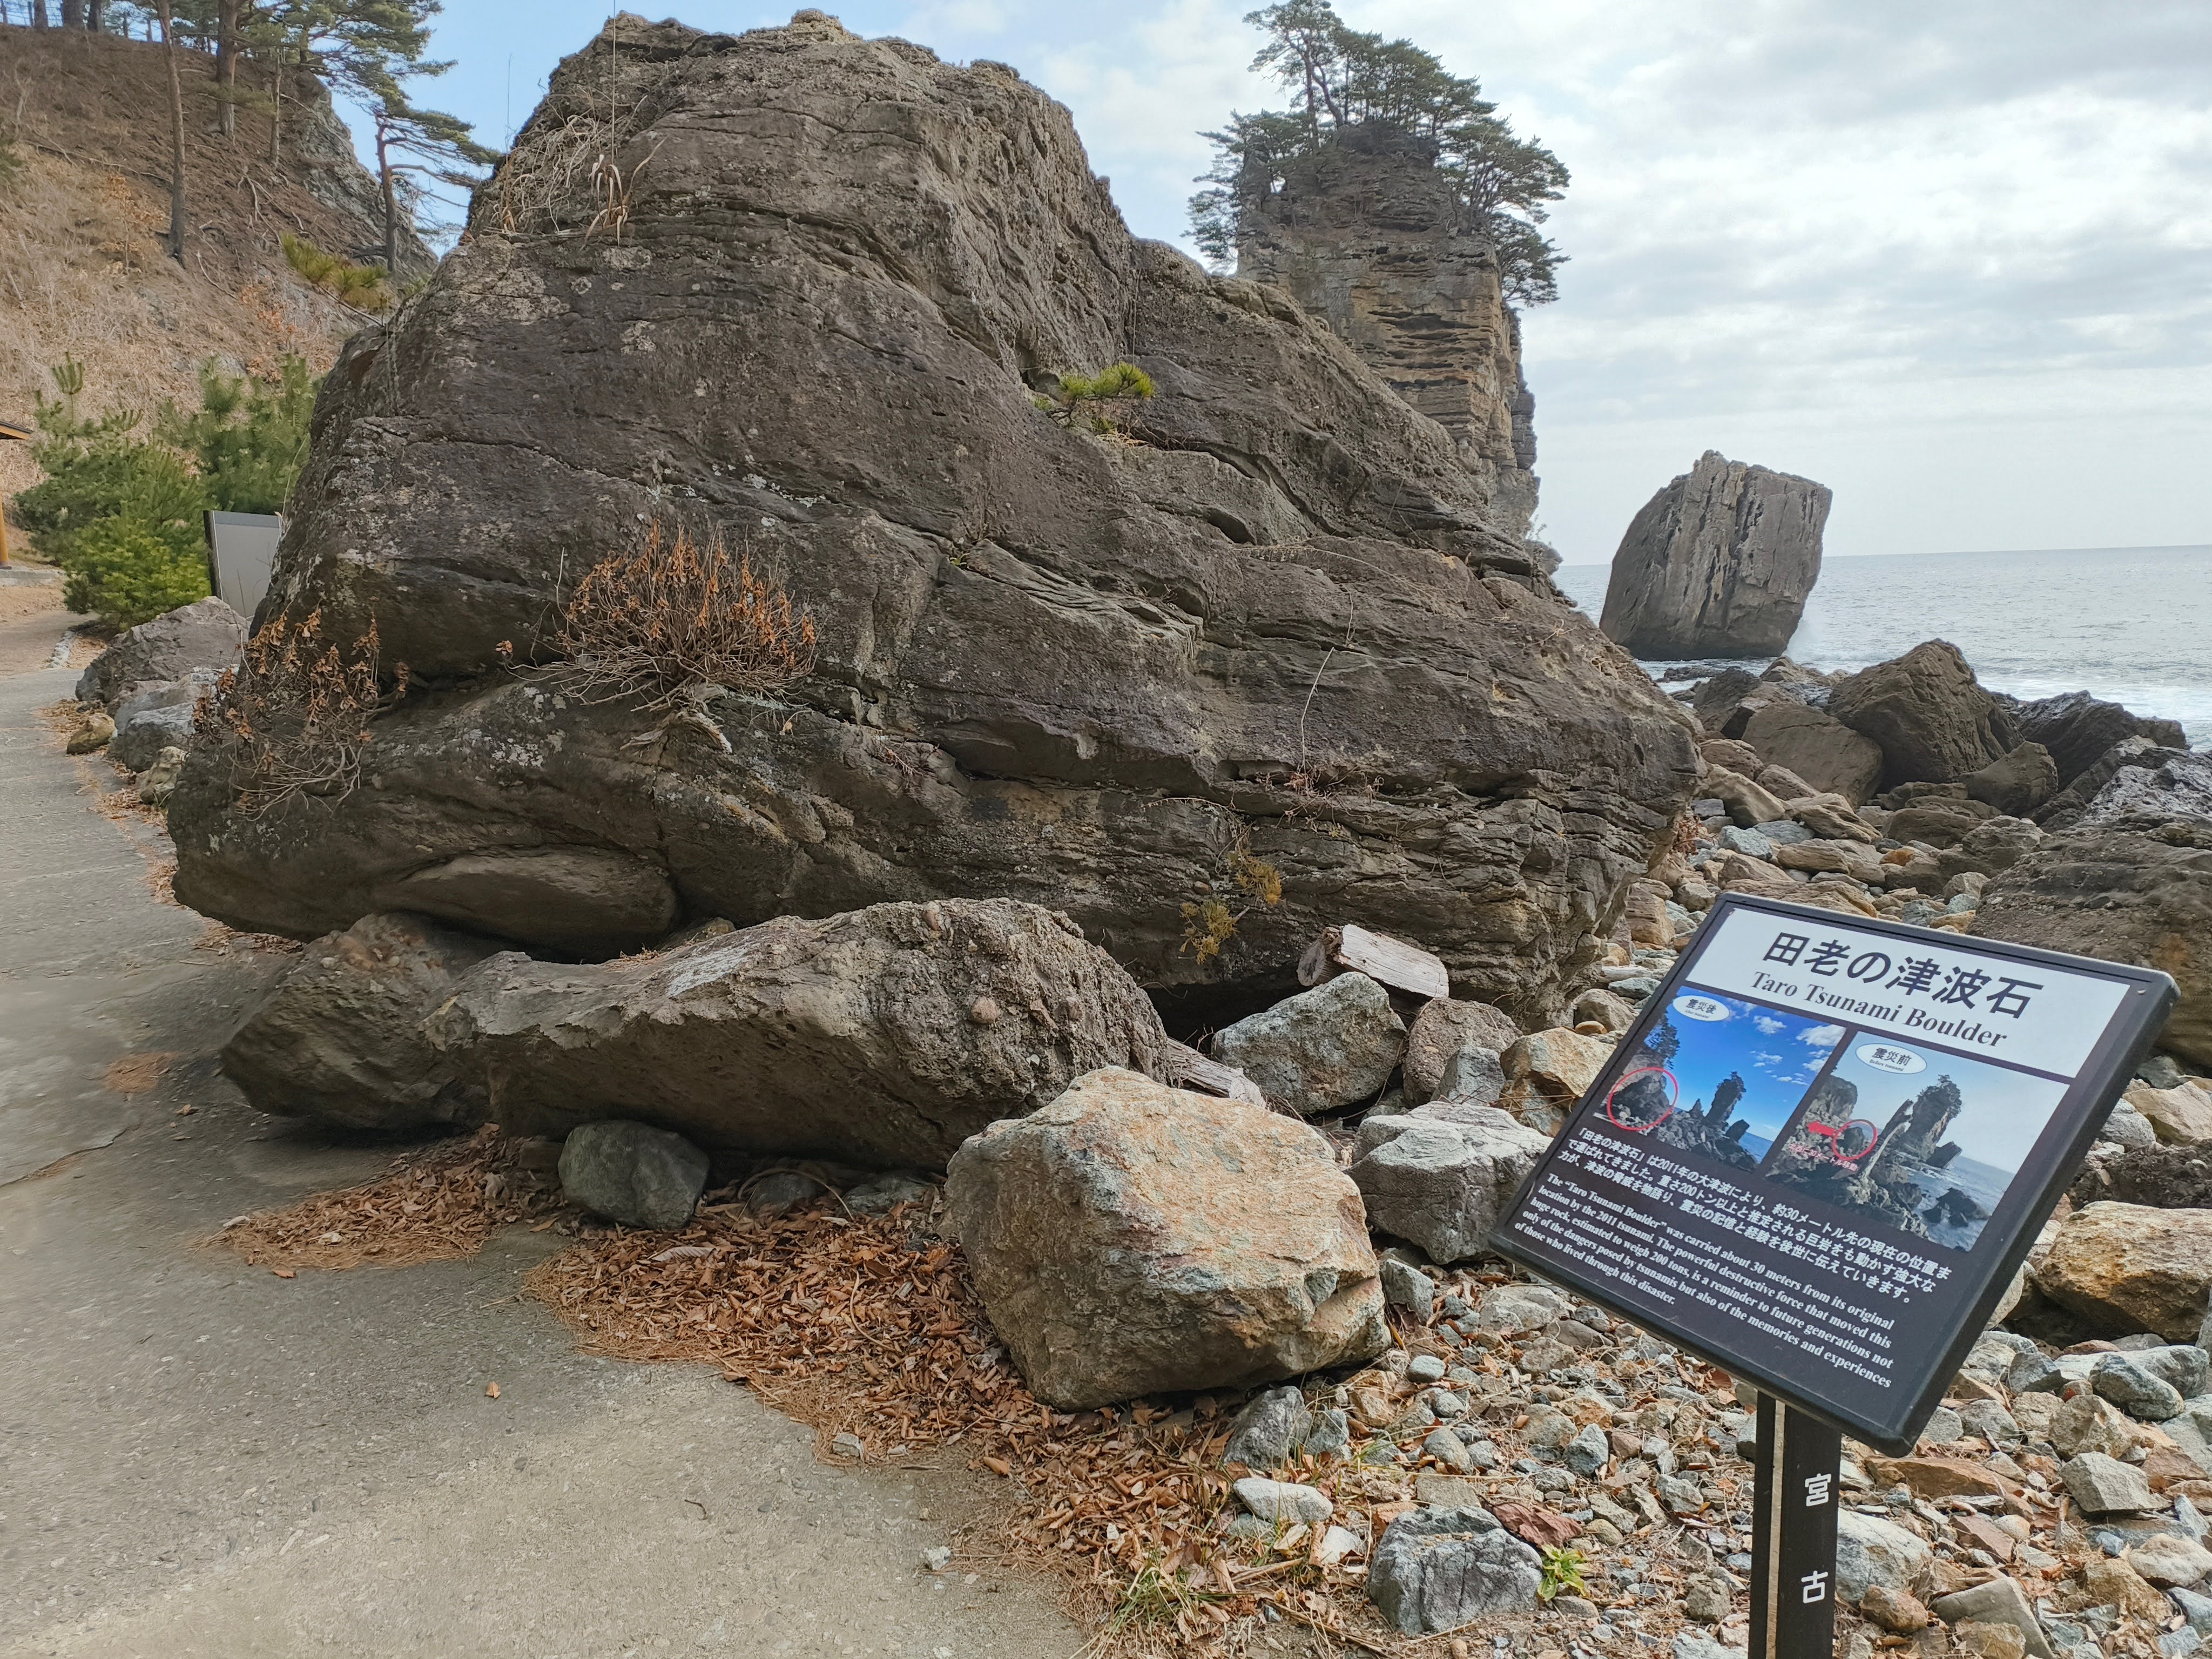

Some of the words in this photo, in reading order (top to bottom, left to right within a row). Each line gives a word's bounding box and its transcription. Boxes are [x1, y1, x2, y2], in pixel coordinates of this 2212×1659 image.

[1685, 999, 1716, 1014] 震災後
[1752, 972, 1797, 996] Taro
[1805, 984, 1903, 1022] Tsunami
[1904, 1008, 2007, 1046] Boulder
[1763, 932, 2044, 1019] 田老の津波石
[1872, 1047, 1912, 1066] 震災前
[1515, 1223, 1527, 1231] of
[1523, 1226, 1546, 1241] those
[1546, 1237, 1563, 1250] who
[1562, 1244, 1586, 1260] lived
[1584, 1255, 1620, 1277] through
[1620, 1272, 1638, 1286] this
[1637, 1280, 1675, 1305] disaster.
[1538, 1185, 1570, 1205] location
[1569, 1199, 1582, 1212] by
[1581, 1205, 1596, 1217] the
[1595, 1211, 1617, 1226] 2011
[1616, 1221, 1655, 1244] tsunami.
[1656, 1237, 1675, 1252] The
[1673, 1247, 1720, 1272] powerful
[1718, 1266, 1775, 1297] destructive
[1775, 1291, 1804, 1310] force
[1805, 1304, 1829, 1320] that
[1829, 1316, 1869, 1338] moved
[1869, 1332, 1892, 1348] this
[1547, 1173, 1563, 1186] The
[1588, 1191, 1626, 1213] Tsunami
[1666, 1226, 1685, 1239] was
[1684, 1235, 1722, 1255] carried
[1720, 1251, 1751, 1268] about
[1750, 1262, 1766, 1274] 30
[1764, 1270, 1802, 1290] meters
[1802, 1284, 1831, 1303] from
[1830, 1296, 1846, 1310] its
[1847, 1305, 1895, 1338] original
[1557, 1150, 1910, 1303] 力が、津波の脅威を物語り、震災の記憶と経験を後世に伝えていきます。
[1569, 1139, 1936, 1292] で運ばれてきました。重さ200トン以上と推定される巨岩をも動かす強大な
[1579, 1127, 1952, 1280] 「田老の津波石」は2011年の大津波により、約30メートル先の現在の位置ま
[1522, 1211, 1541, 1224] only
[1540, 1219, 1553, 1228] of
[1549, 1222, 1564, 1234] the
[1563, 1229, 1598, 1250] dangers
[1595, 1245, 1625, 1262] posed
[1623, 1256, 1637, 1269] by
[1636, 1263, 1678, 1288] tsunamis
[1678, 1281, 1697, 1297] but
[1696, 1292, 1717, 1306] also
[1717, 1302, 1732, 1312] of
[1729, 1306, 1747, 1320] the
[1747, 1316, 1800, 1345] memories
[1800, 1341, 1825, 1356] and
[1824, 1352, 1892, 1388] experiences
[1530, 1197, 1551, 1212] huge
[1549, 1208, 1570, 1223] rock,
[1572, 1218, 1614, 1240] estimated
[1612, 1235, 1622, 1245] to
[1623, 1240, 1650, 1258] weigh
[1649, 1251, 1669, 1265] 200
[1668, 1260, 1690, 1278] tons,
[1691, 1270, 1702, 1281] is
[1701, 1277, 1709, 1285] a
[1709, 1280, 1758, 1306] reminder
[1757, 1301, 1770, 1312] to
[1770, 1306, 1805, 1328] future
[1803, 1324, 1871, 1359] generations
[1871, 1354, 1894, 1368] not
